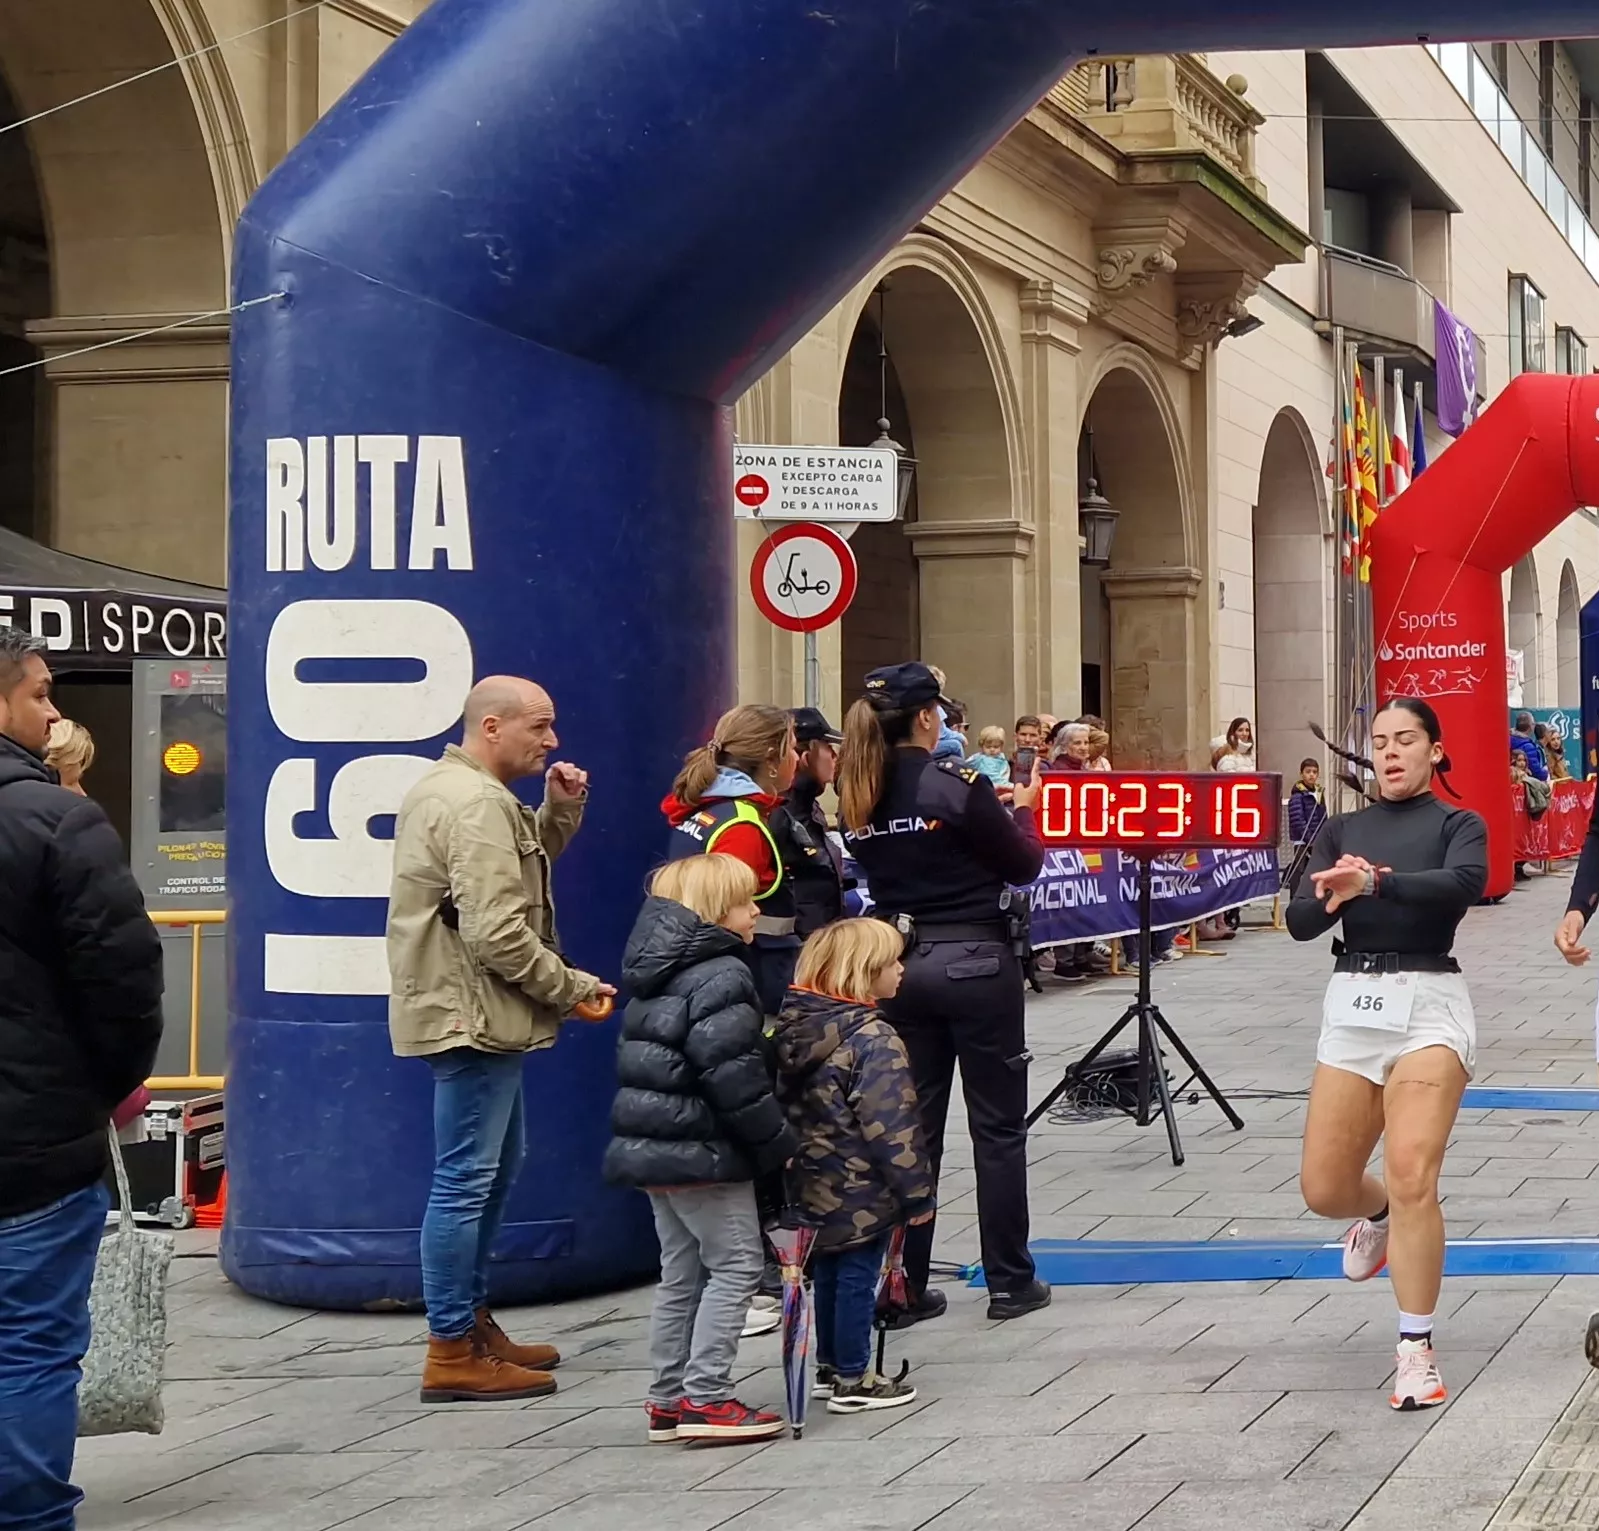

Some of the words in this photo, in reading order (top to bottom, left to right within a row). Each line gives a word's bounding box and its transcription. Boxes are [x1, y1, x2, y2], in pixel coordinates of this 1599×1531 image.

[735, 456, 777, 467] ZONA
[782, 457, 801, 467] DE
[807, 457, 884, 469] ESTANCIA
[781, 472, 836, 482] EXCEPTO
[841, 473, 883, 483] CARGA
[781, 486, 789, 495] Y
[792, 486, 859, 496] DESCARGA
[266, 435, 474, 571] RUTA
[781, 501, 796, 510] DE
[800, 502, 807, 510] 9
[812, 502, 820, 510] A
[824, 502, 833, 511] 11
[837, 502, 879, 511] HORAS
[1398, 610, 1458, 633] Sports
[1395, 640, 1487, 660] Santander
[1042, 782, 1261, 838] 00:23:16
[159, 886, 198, 894] TRAFICO
[1352, 995, 1384, 1012] 436
